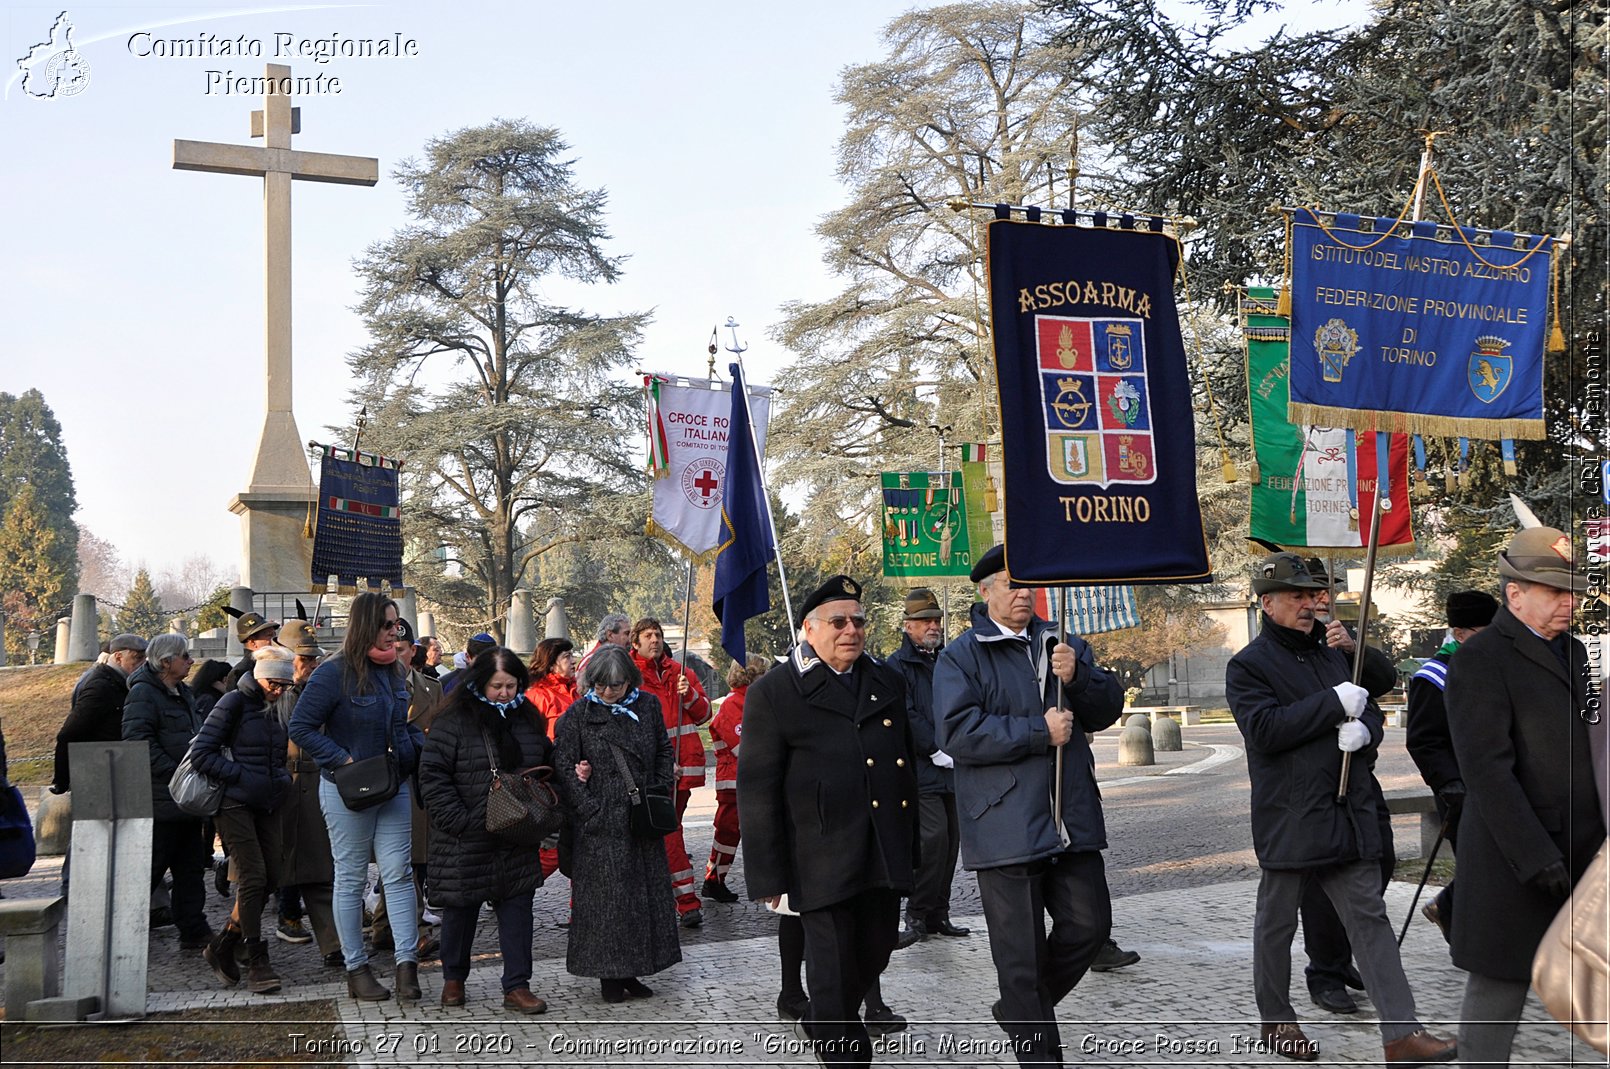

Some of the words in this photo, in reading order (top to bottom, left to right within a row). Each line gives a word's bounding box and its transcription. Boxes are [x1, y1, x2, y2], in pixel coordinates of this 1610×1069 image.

[1311, 244, 1374, 265] ISTITUTO
[1374, 251, 1402, 270] DEL
[1404, 255, 1460, 277] NASTRO
[1462, 262, 1532, 284] AZZURRO
[1018, 280, 1152, 319] ASSOARMA
[1315, 286, 1419, 314] FEDERAZIONE
[1423, 299, 1529, 325] PROVINCIALE
[1402, 328, 1417, 345] DI
[1380, 346, 1437, 367] TORINO
[668, 412, 708, 426] CROCE
[713, 417, 729, 429] RO
[676, 441, 709, 450] COMITATO
[1268, 476, 1332, 492] FEDEAZIONE
[1058, 495, 1151, 523] TORINO
[1309, 500, 1352, 513] TORINES
[888, 552, 937, 567] SEZIONE
[954, 552, 970, 566] TO
[1074, 589, 1107, 599] BOLZANO
[1082, 607, 1090, 615] DI
[1092, 606, 1105, 614] SAN
[1107, 603, 1127, 613] SABBA
